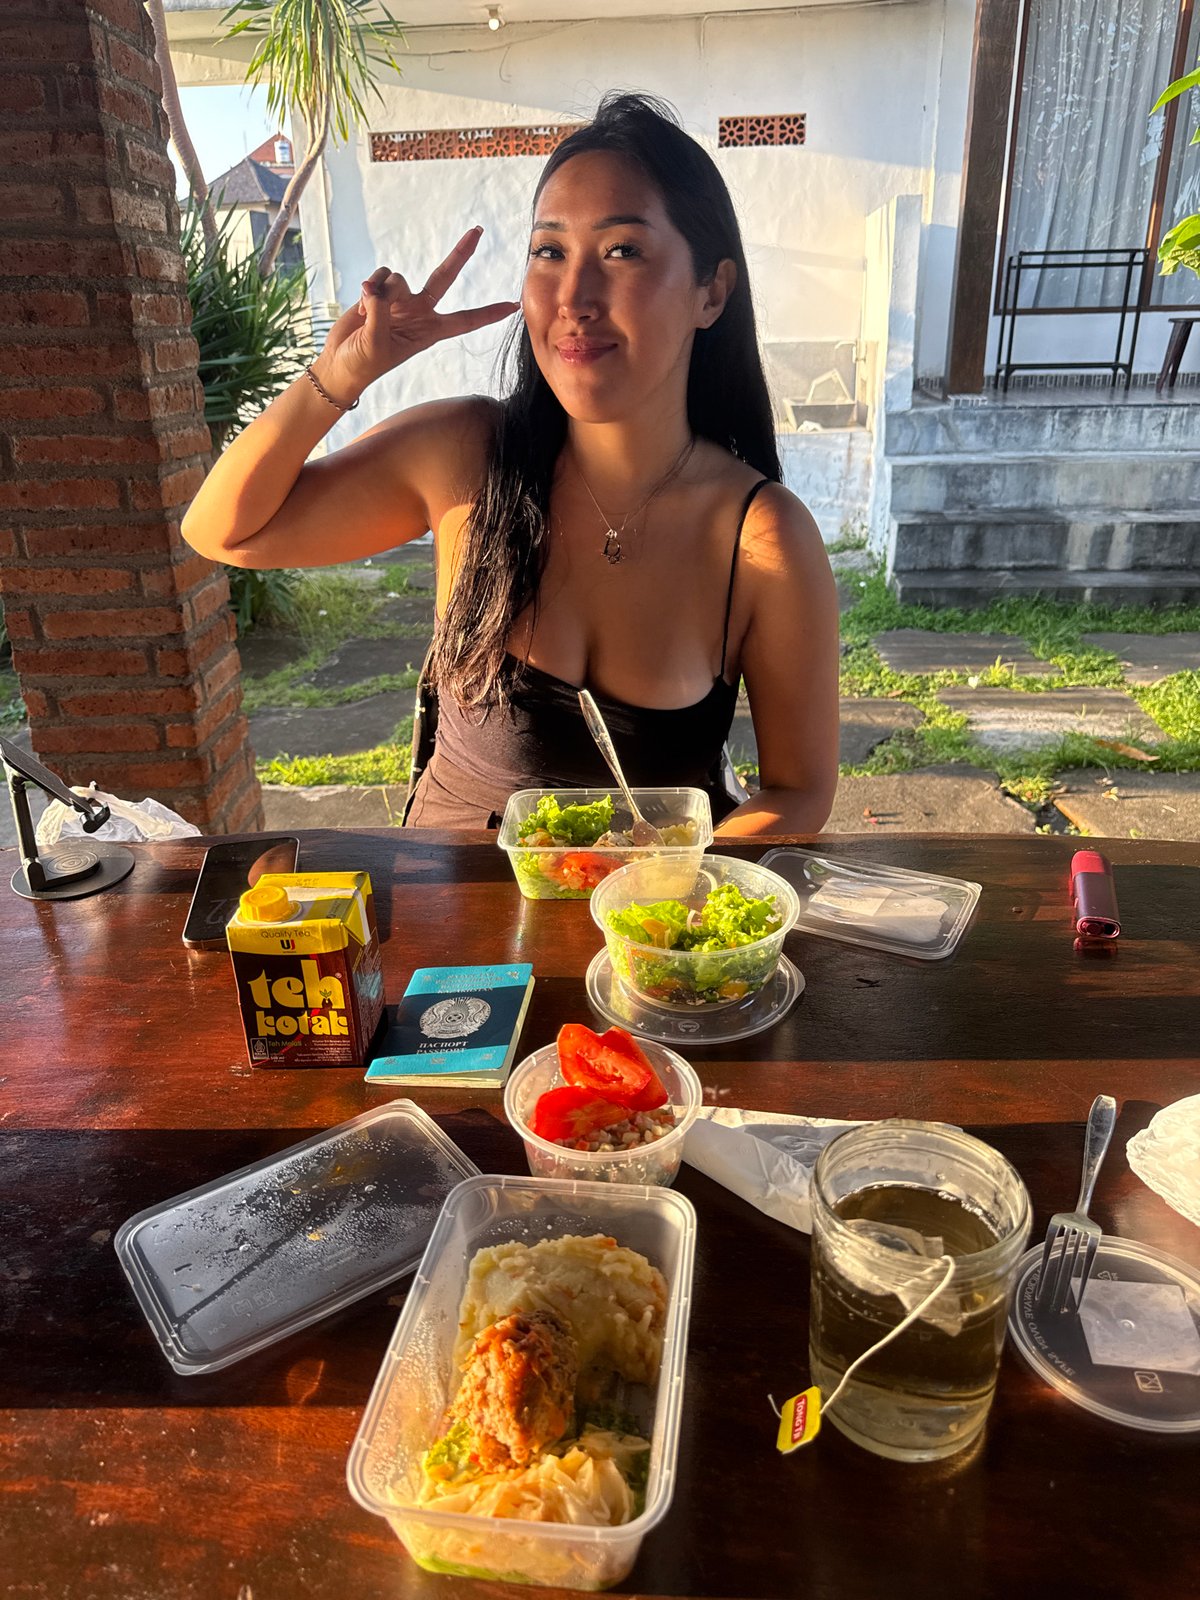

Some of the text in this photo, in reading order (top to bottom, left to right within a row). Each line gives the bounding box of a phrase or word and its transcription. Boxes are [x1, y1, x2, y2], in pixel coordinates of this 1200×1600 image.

[261, 929, 311, 939] Quality Tea
[248, 960, 346, 1010] teh
[255, 1010, 349, 1037] kotak
[419, 1041, 468, 1049] ПАСПОРТ
